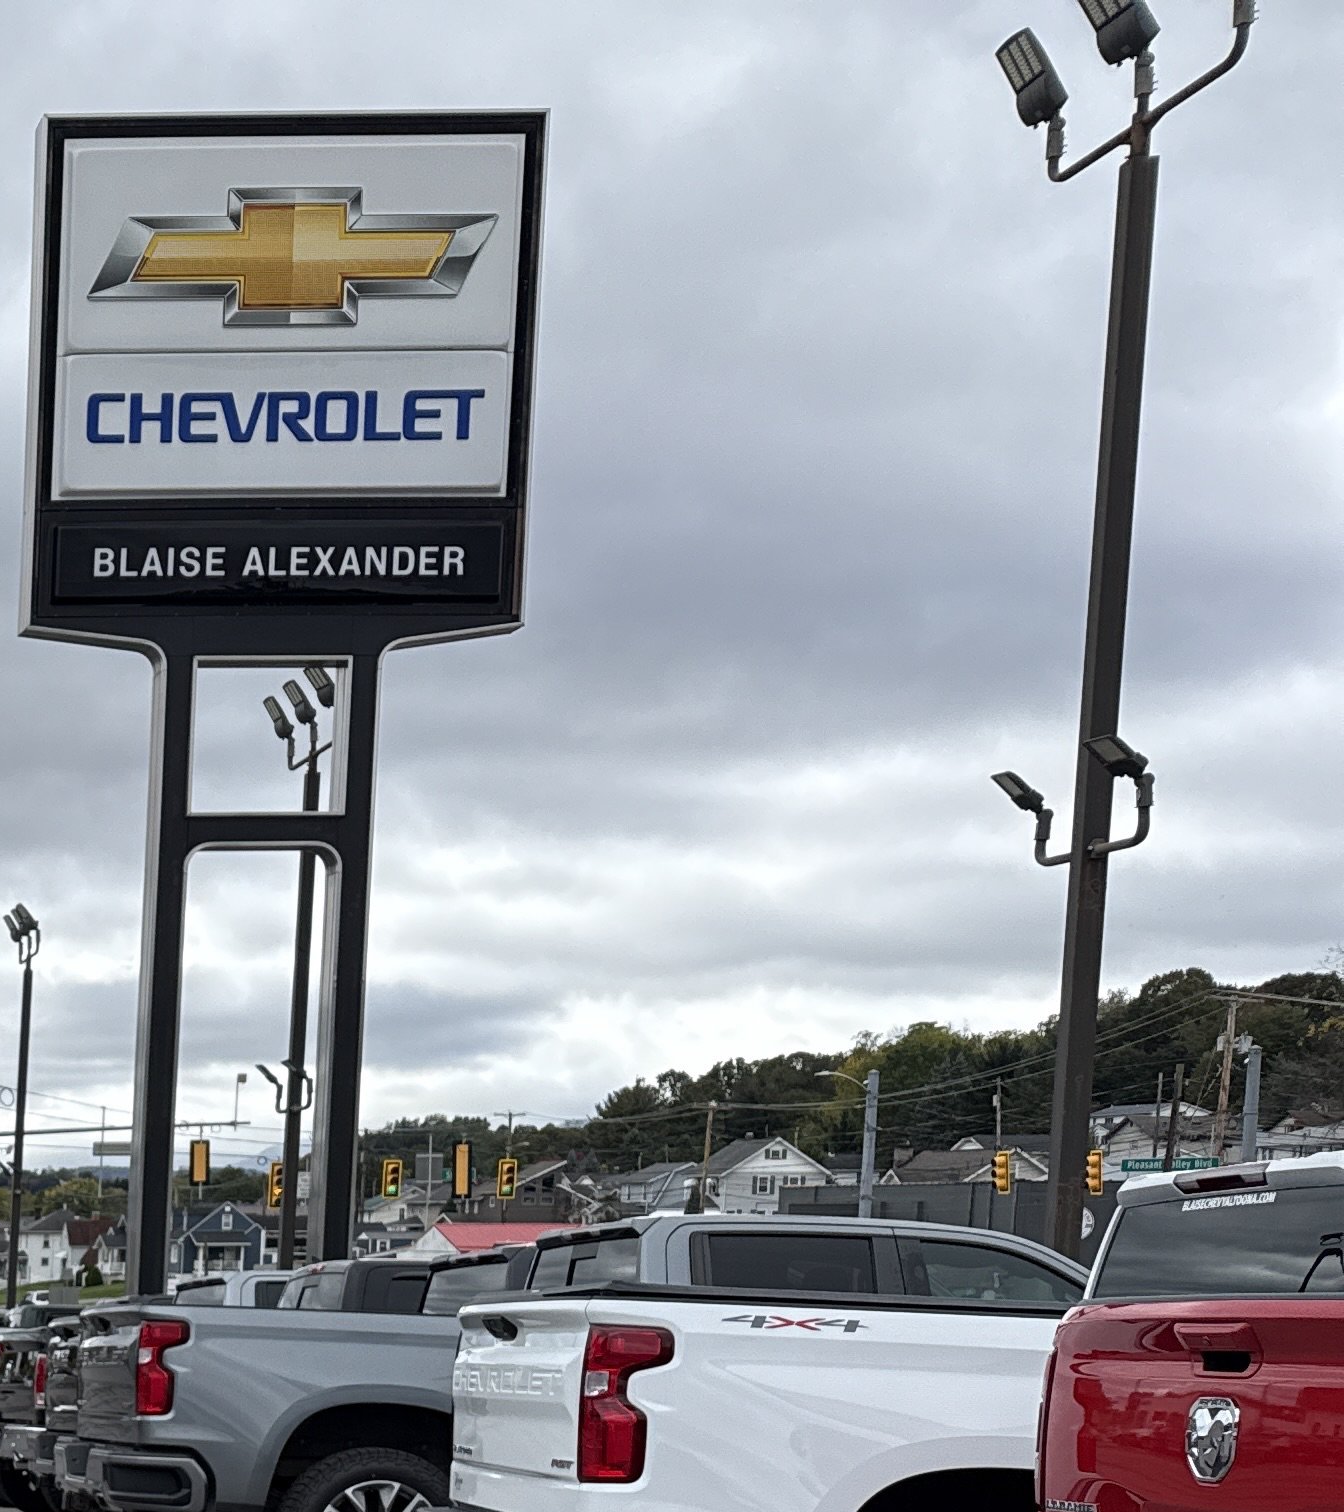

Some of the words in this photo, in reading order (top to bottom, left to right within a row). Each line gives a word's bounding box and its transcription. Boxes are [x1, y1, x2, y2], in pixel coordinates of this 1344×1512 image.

[86, 388, 486, 443] CHEVROLET
[93, 546, 227, 577] BLAISE
[241, 545, 466, 576] ALEXANDER
[1127, 1160, 1163, 1170] Pleasant
[1172, 1160, 1192, 1170] lley
[1195, 1158, 1213, 1169] Blvd
[452, 1369, 563, 1395] CHEVROLET
